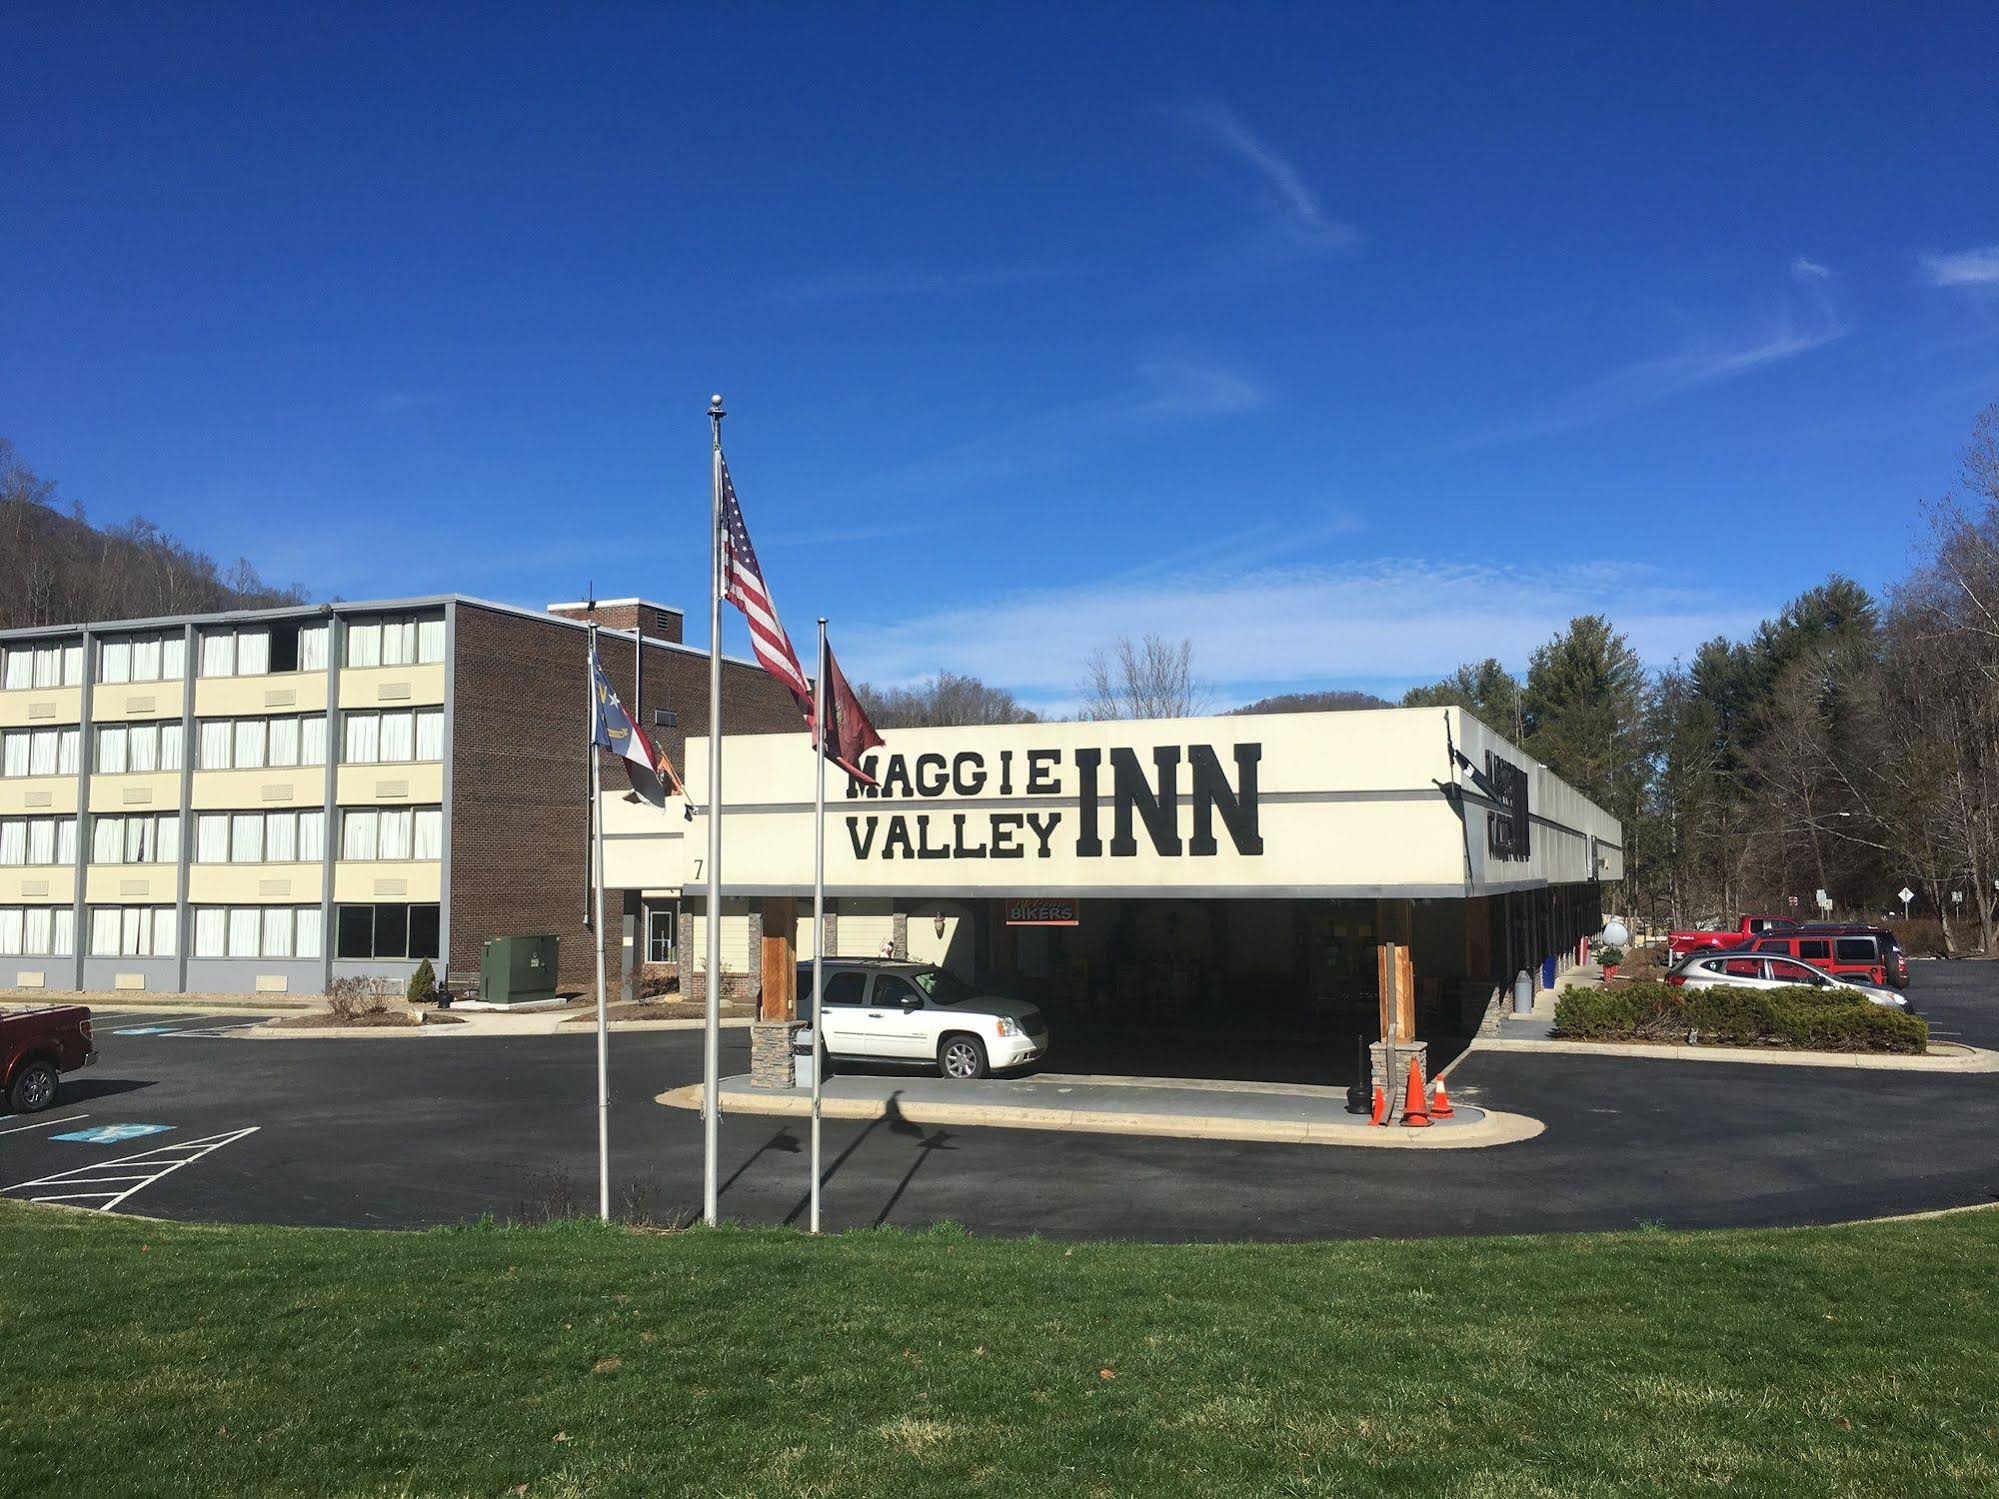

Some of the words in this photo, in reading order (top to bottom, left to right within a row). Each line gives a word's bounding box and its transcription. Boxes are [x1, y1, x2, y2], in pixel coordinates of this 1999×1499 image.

[846, 749, 1062, 799] MAGGIE
[1075, 742, 1264, 858] INN
[845, 812, 1062, 860] VALLEY
[693, 859, 704, 880] 7
[1011, 907, 1073, 919] BIKERS
